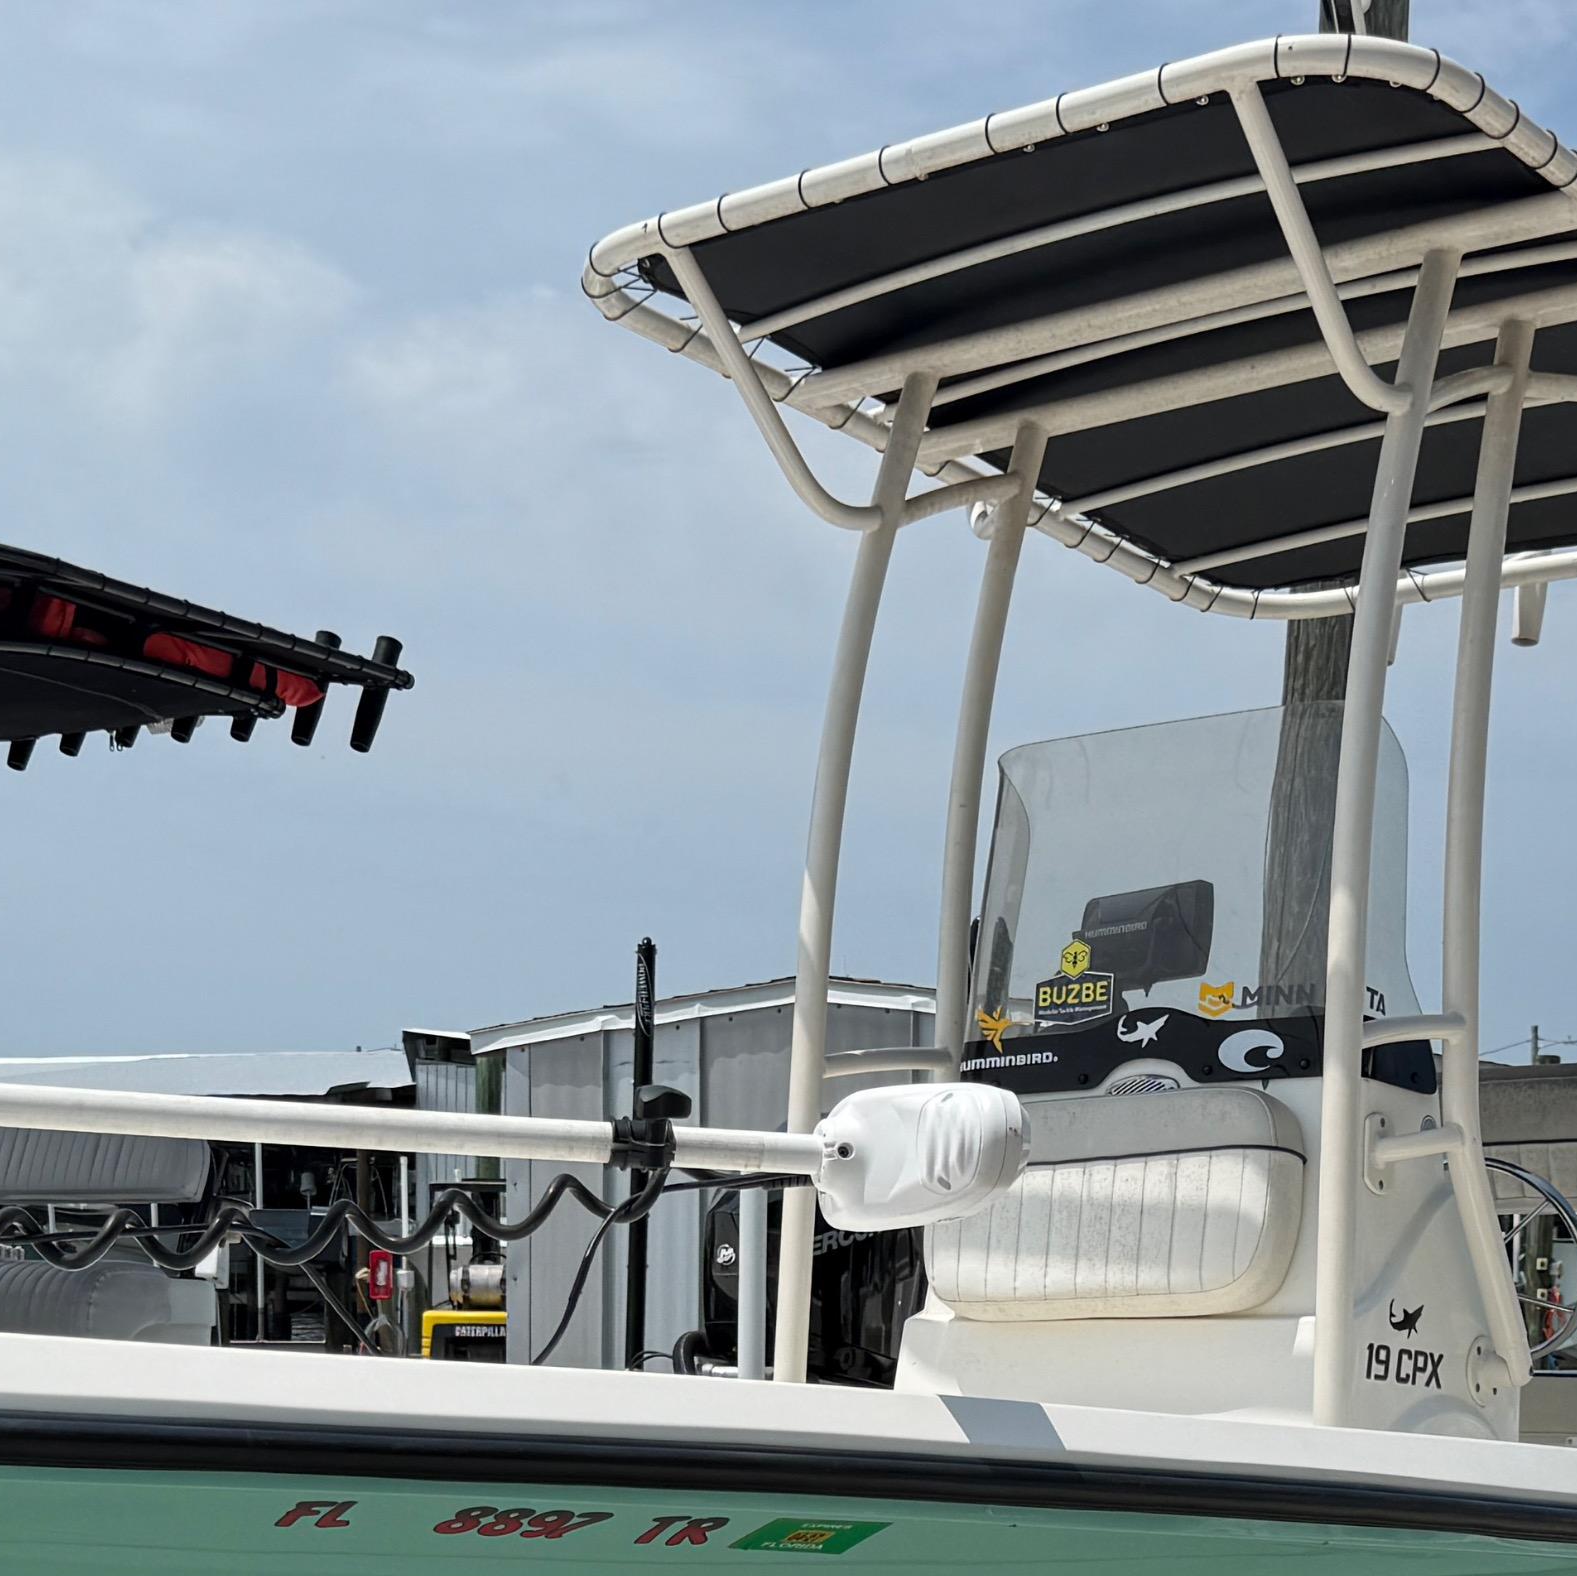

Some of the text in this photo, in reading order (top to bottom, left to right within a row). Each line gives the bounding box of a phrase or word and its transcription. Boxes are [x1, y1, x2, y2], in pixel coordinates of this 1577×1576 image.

[1038, 980, 1109, 1007] BUZBE
[1241, 982, 1316, 1008] MINN
[1366, 1342, 1444, 1389] 19 CPX
[274, 1500, 730, 1546] FL 8897 TR
